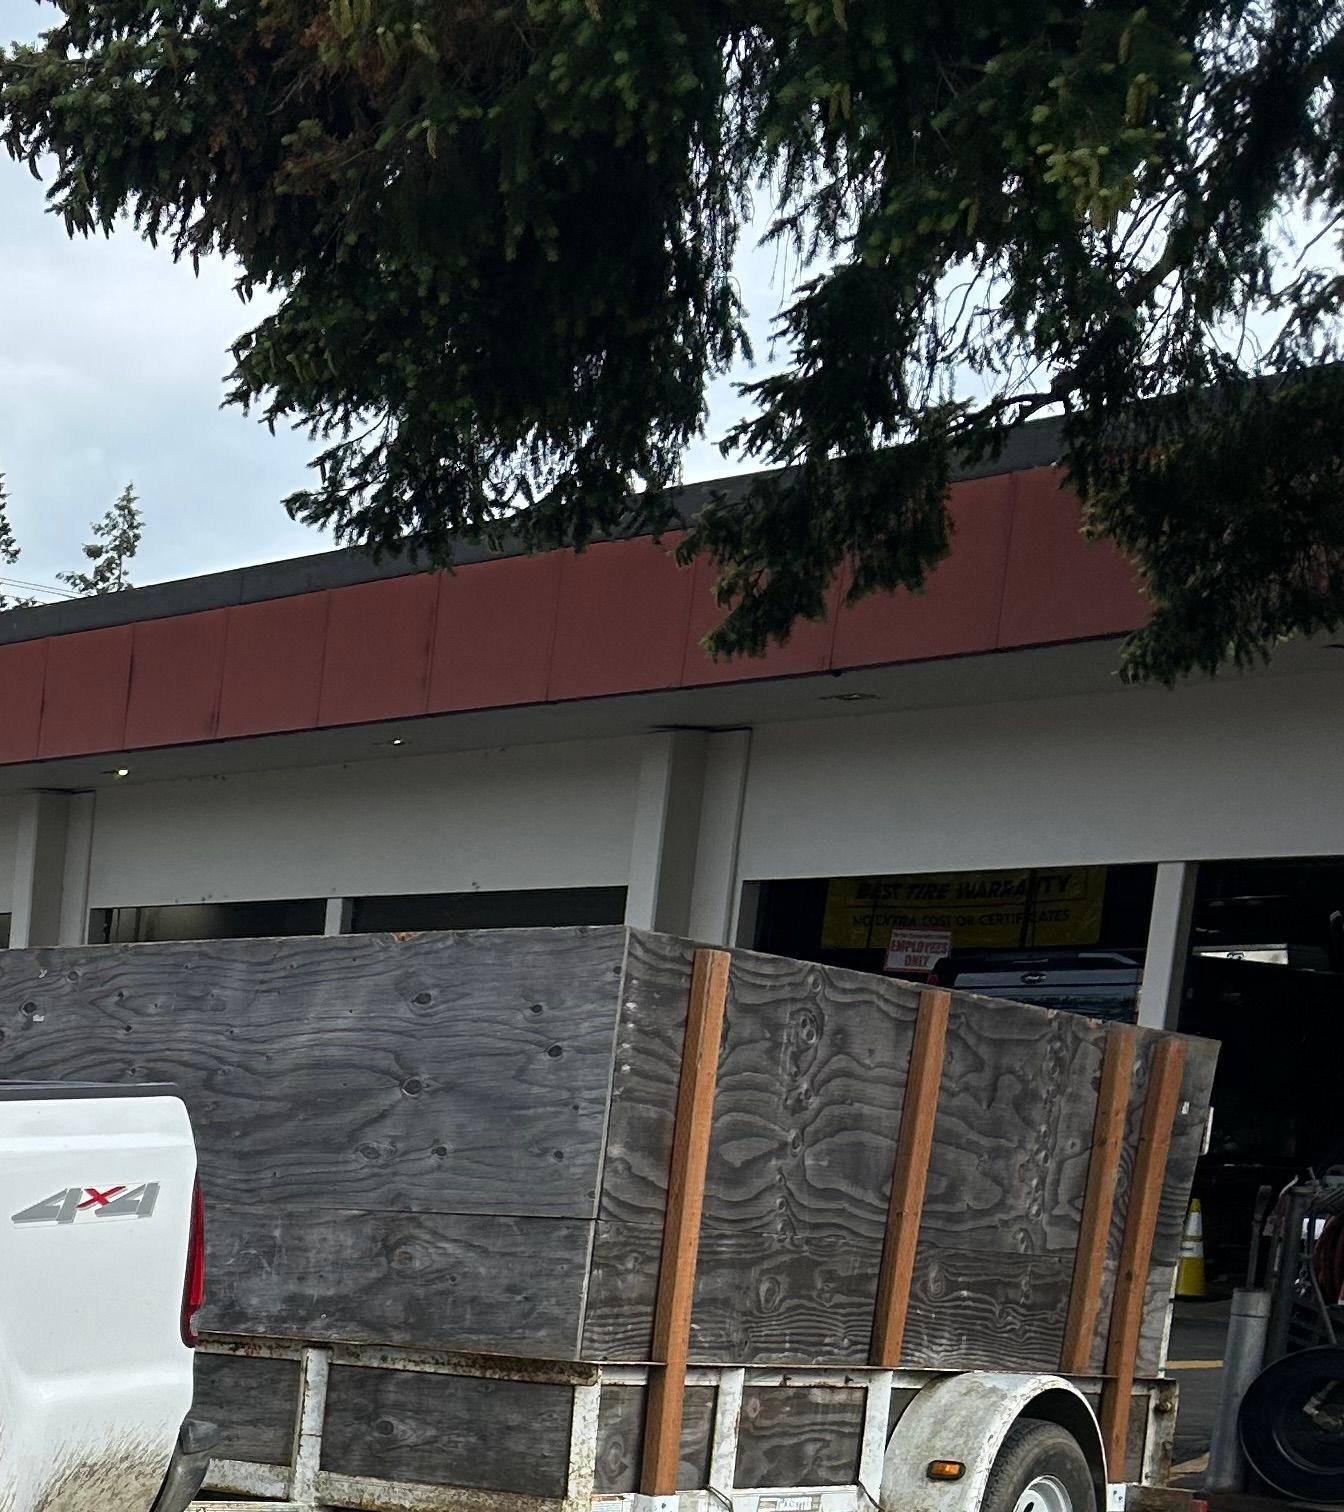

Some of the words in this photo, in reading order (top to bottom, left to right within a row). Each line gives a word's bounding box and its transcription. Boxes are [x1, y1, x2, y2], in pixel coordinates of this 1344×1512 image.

[905, 881, 950, 899] TIRE
[979, 909, 1070, 927] CERTIFCATES
[890, 940, 949, 954] EMPLOYEES
[904, 954, 930, 967] ONLY
